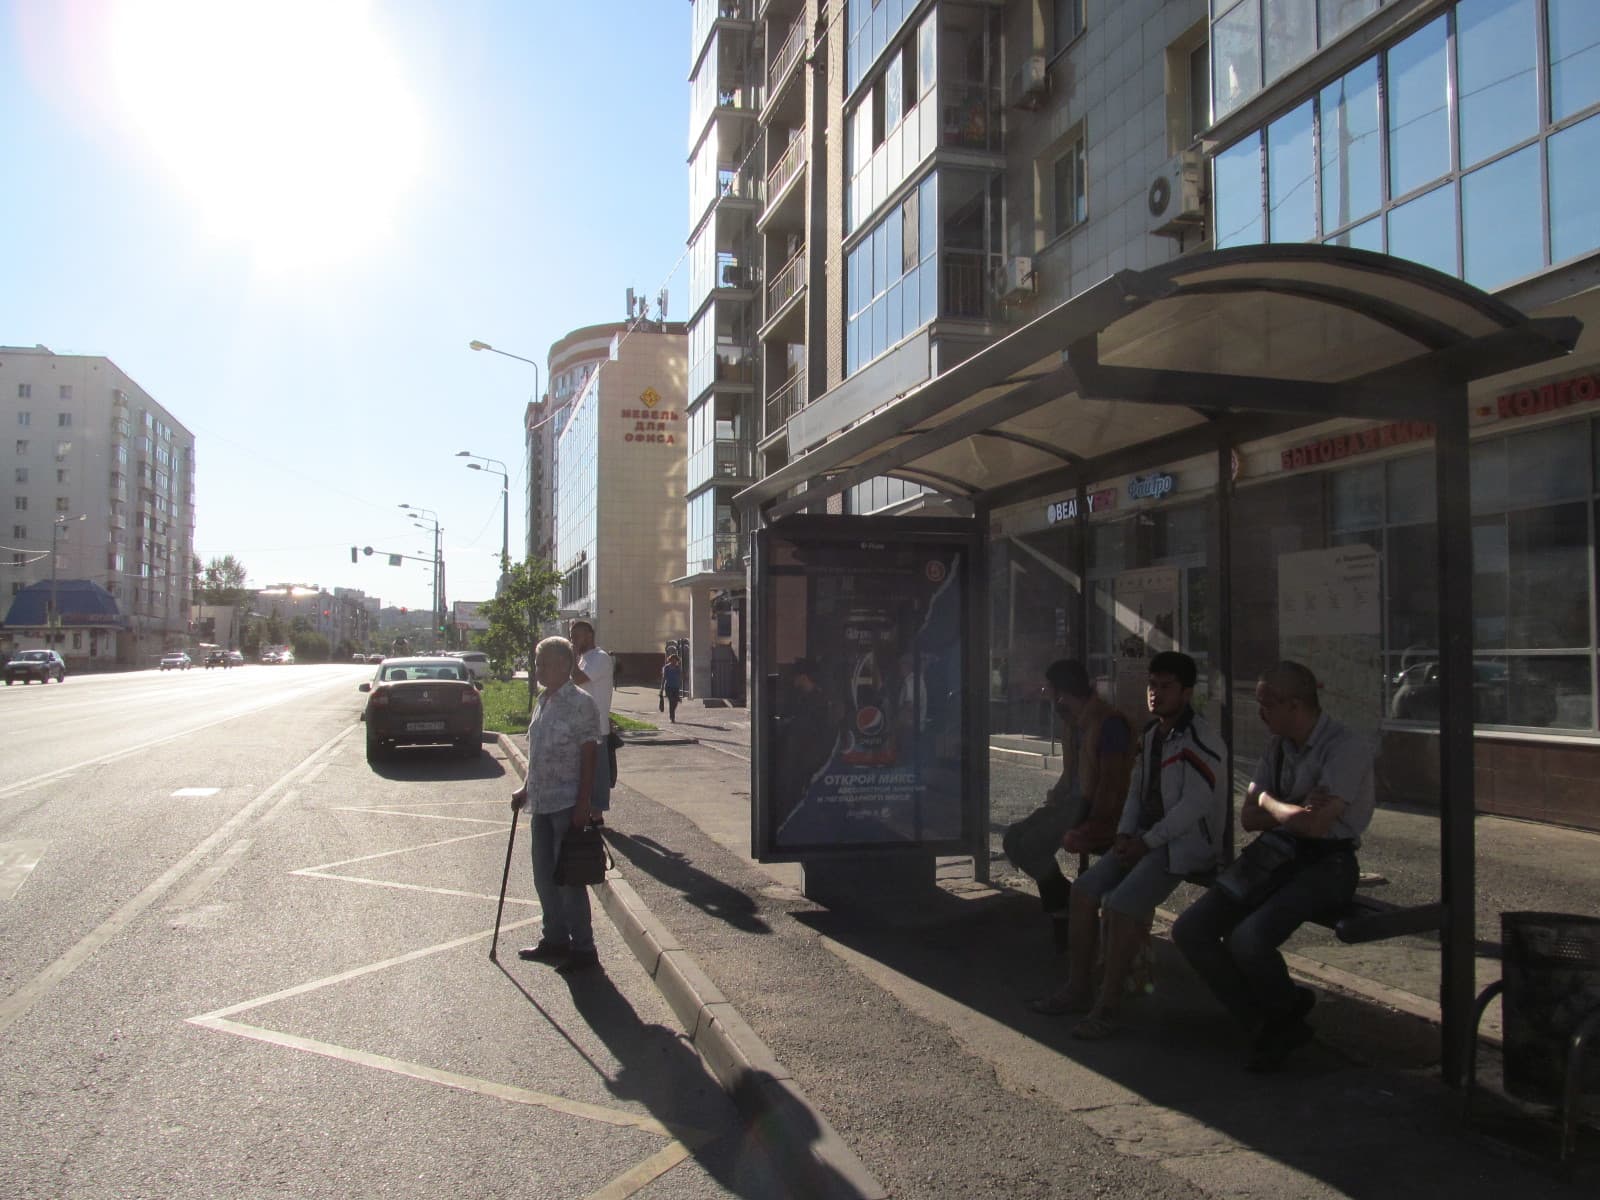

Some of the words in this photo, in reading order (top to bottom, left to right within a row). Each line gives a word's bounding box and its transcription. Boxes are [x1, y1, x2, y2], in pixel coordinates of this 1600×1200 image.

[1496, 374, 1600, 418] КОЛГО
[621, 409, 678, 421] МЕБЕЛЬ
[634, 421, 665, 431] ДЛЯ
[624, 432, 674, 443] ОФИСА
[1280, 428, 1381, 471] БЫТОВАЯ
[1382, 421, 1437, 446] ХИМИ
[824, 774, 875, 785] ОТКРОЙ
[878, 773, 915, 784] МИКС
